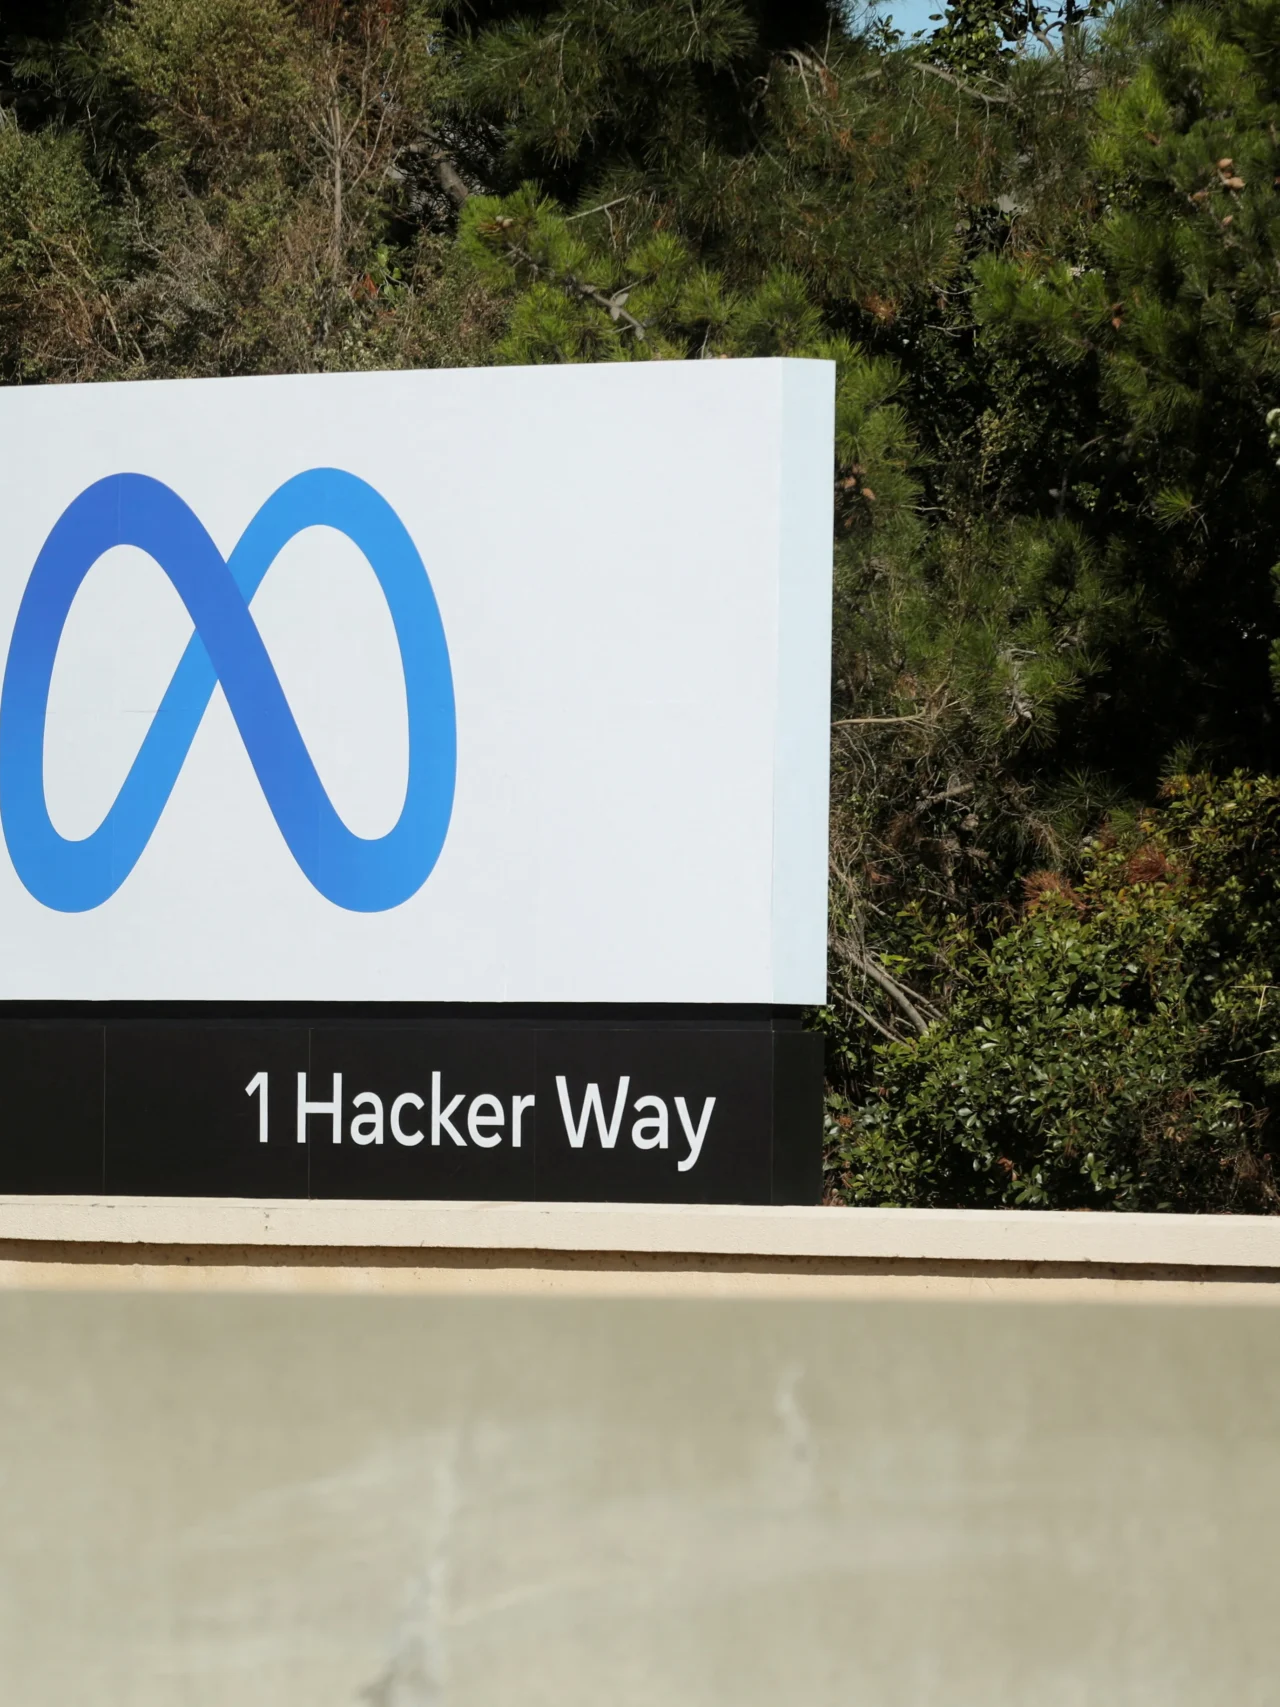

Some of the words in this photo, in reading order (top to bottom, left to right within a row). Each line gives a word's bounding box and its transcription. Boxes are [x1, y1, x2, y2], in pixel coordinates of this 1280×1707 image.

[244, 1071, 269, 1143] 1
[296, 1071, 537, 1149] Hacker
[556, 1075, 718, 1173] Way
